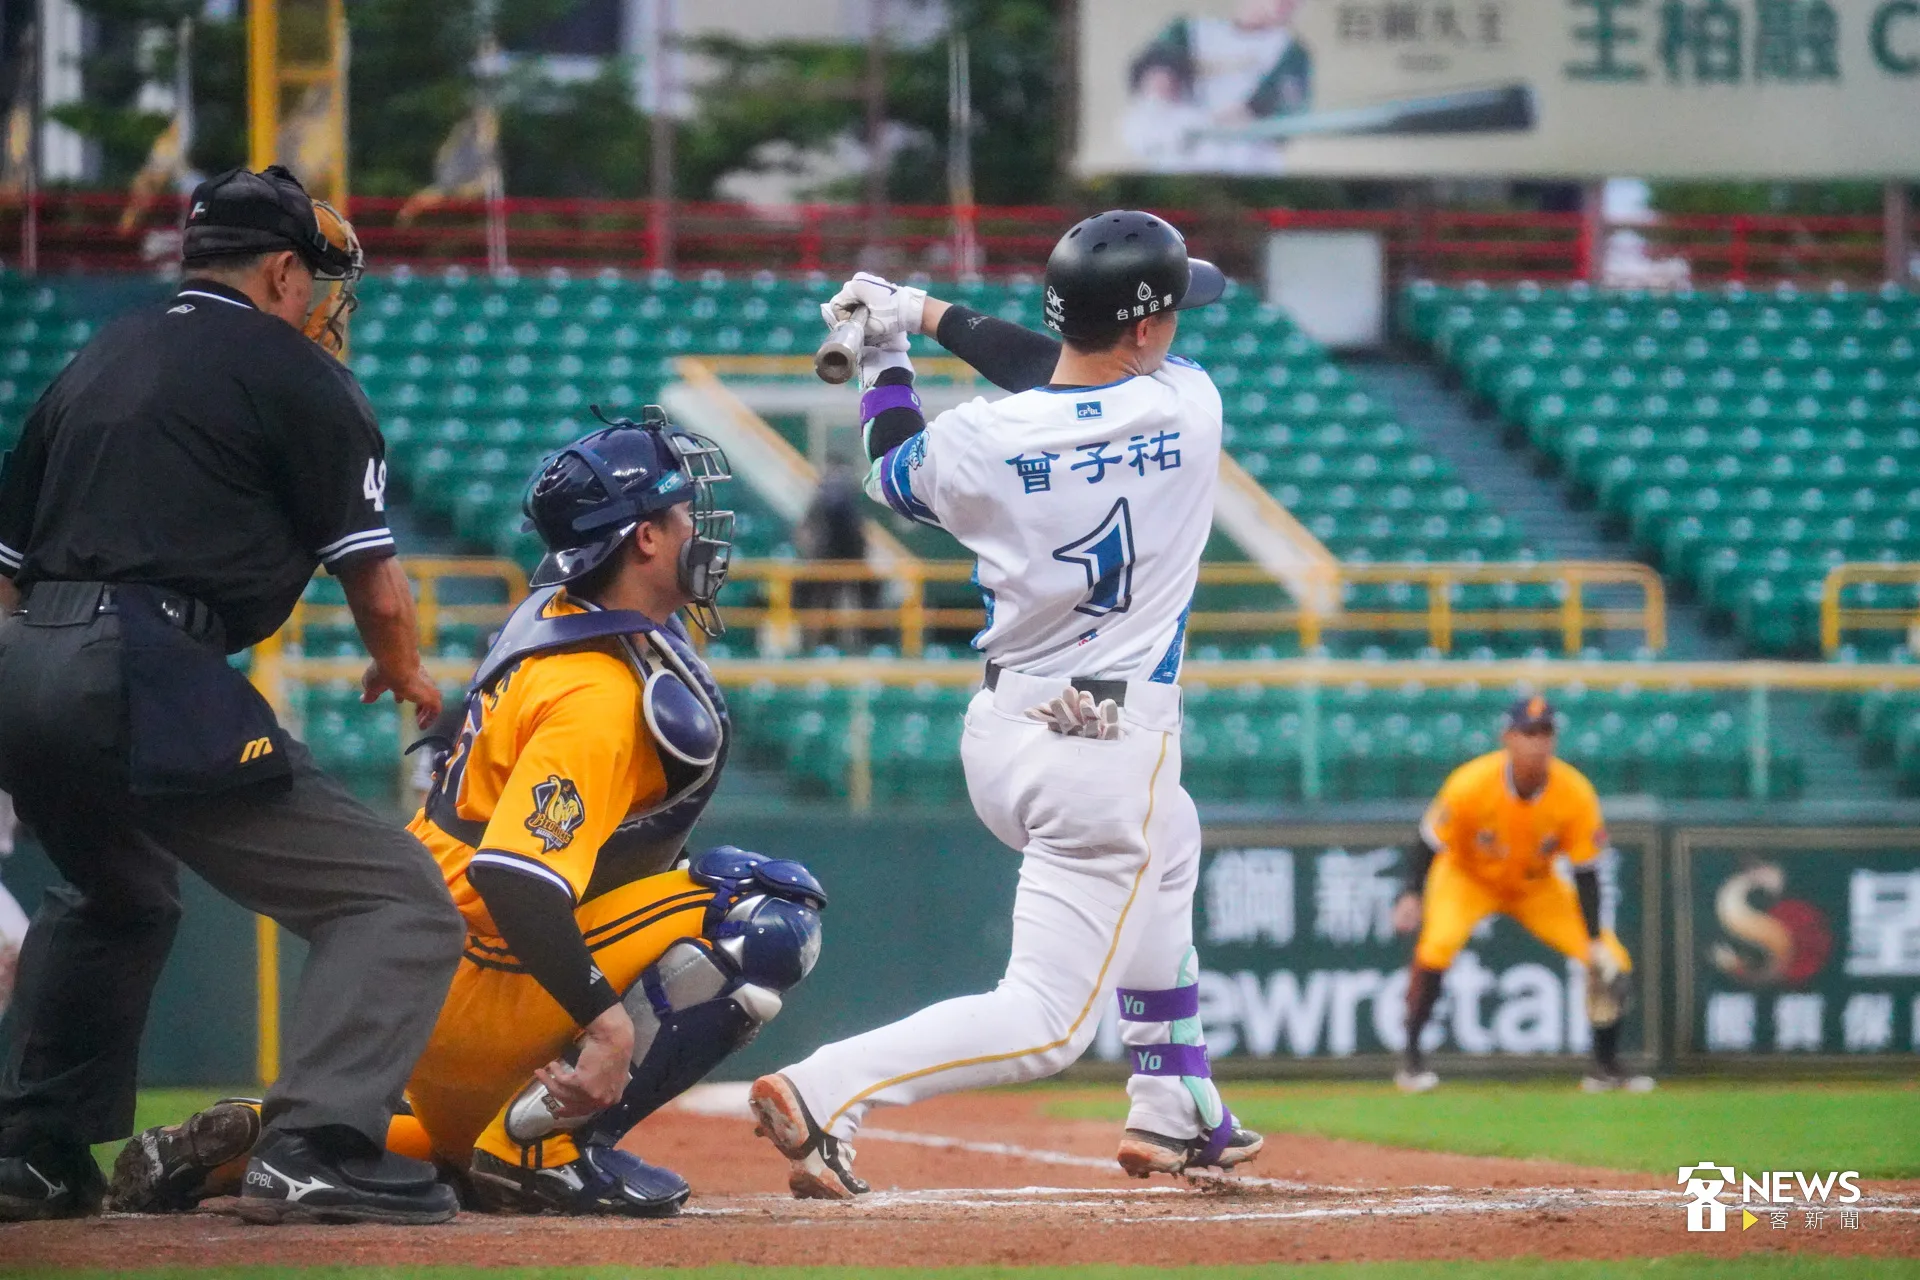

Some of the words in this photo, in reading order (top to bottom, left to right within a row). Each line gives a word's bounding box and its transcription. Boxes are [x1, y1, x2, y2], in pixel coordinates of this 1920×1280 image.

[1005, 430, 1182, 495] 曾子祐
[1052, 496, 1137, 618] 1
[1122, 994, 1146, 1016] Yo
[1137, 1051, 1163, 1072] Yo
[246, 1171, 274, 1189] CPBL
